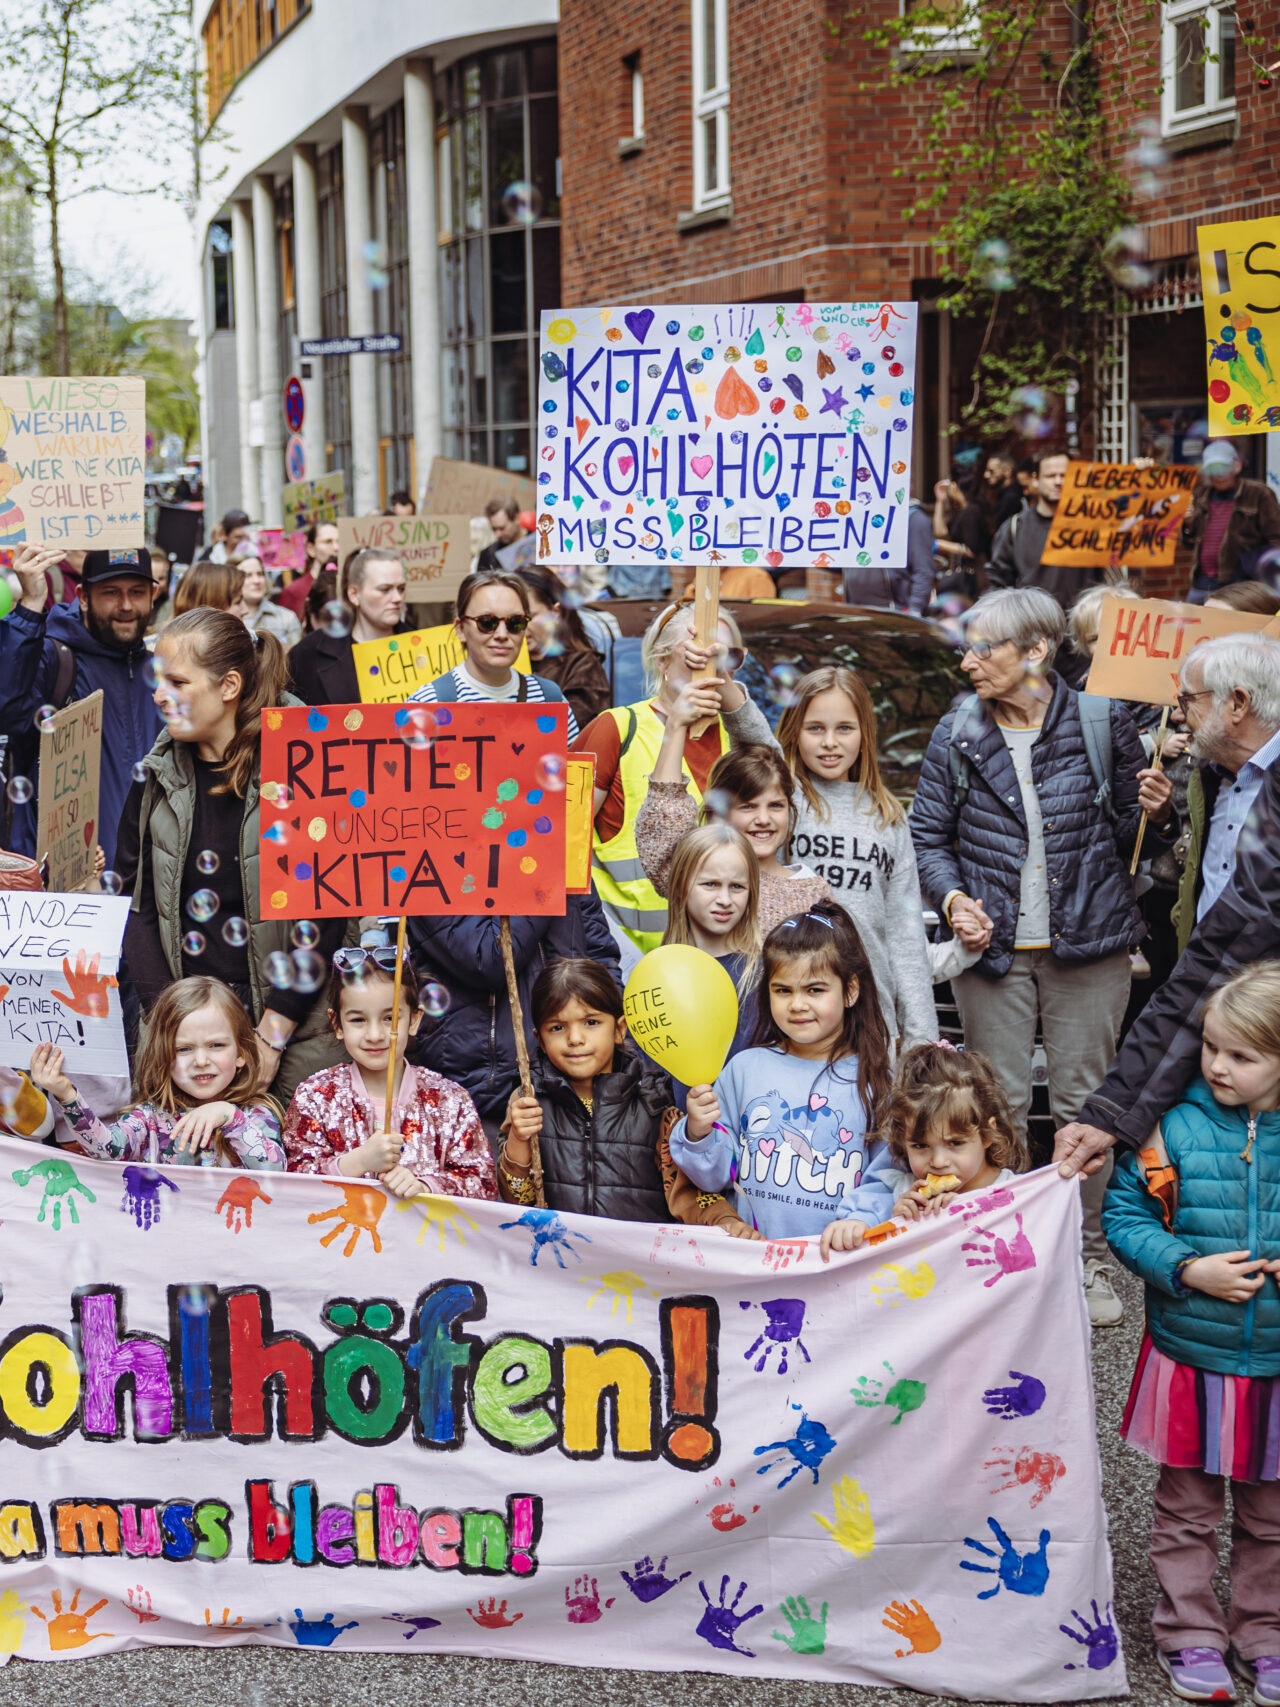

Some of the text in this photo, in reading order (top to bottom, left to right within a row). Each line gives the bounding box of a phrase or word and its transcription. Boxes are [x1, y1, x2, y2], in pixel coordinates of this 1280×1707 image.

[821, 313, 849, 324] UND
[25, 379, 119, 411] WIESO
[566, 346, 697, 427] KITA
[34, 434, 142, 457] WARUM?
[16, 459, 64, 480] WER
[105, 457, 144, 478] KITA
[1074, 468, 1142, 490] LIEBER
[1064, 494, 1128, 520] LÄUSE
[40, 515, 78, 540] IST
[353, 520, 450, 548] WIR SIND
[558, 515, 664, 553] MUSS
[1109, 608, 1202, 660] HALT
[376, 650, 418, 686] ICH
[51, 718, 79, 760] NICHT
[81, 707, 100, 741] MAL
[53, 750, 88, 801] ELSA
[287, 735, 496, 800] RETTET
[47, 804, 64, 846] HAT
[66, 798, 79, 828] SO
[332, 805, 469, 844] UNSERE
[53, 829, 81, 868] KALTES
[815, 864, 872, 891] 1974
[0, 971, 43, 987] VON
[2, 997, 66, 1018] MEINER
[9, 1019, 85, 1046] KITA!
[755, 1189, 766, 1198] BIG
[795, 1197, 811, 1207] BIG
[48, 1498, 233, 1564] muss
[244, 1477, 544, 1578] bleiben!
